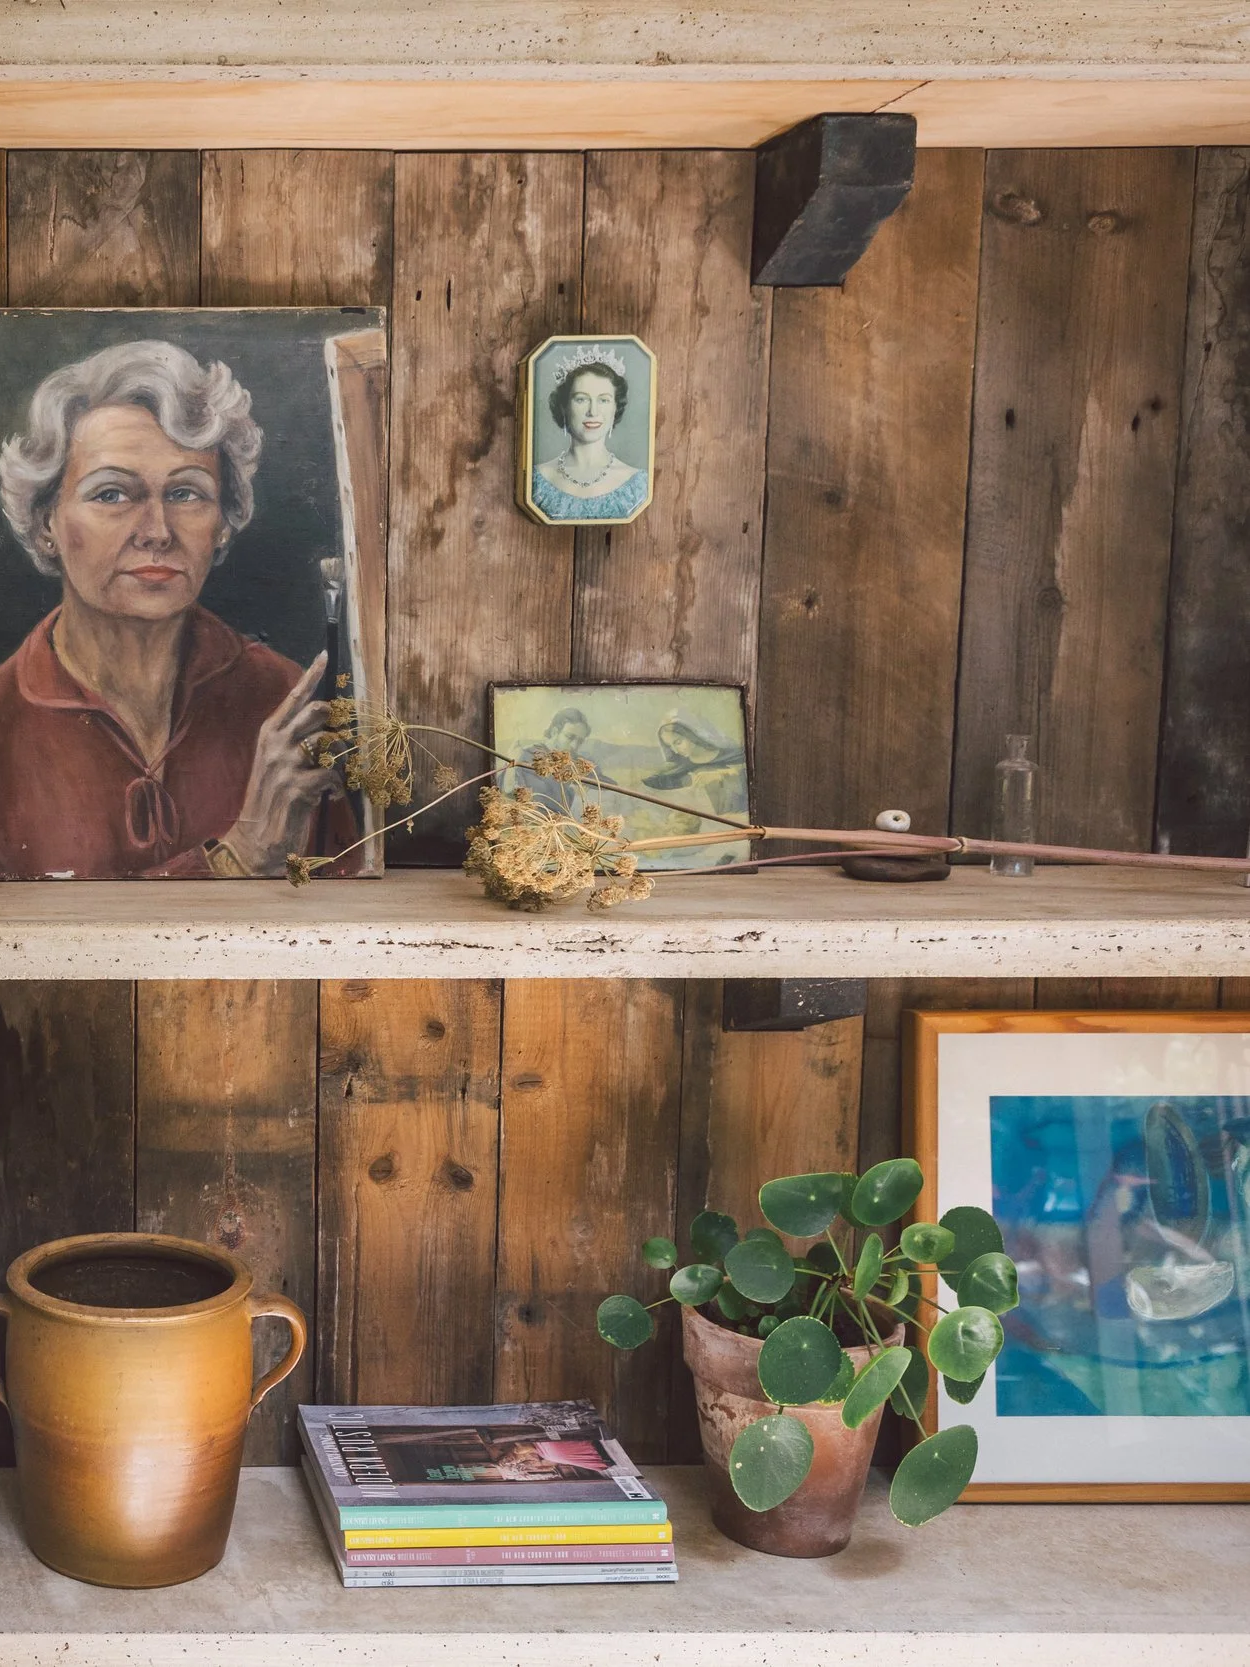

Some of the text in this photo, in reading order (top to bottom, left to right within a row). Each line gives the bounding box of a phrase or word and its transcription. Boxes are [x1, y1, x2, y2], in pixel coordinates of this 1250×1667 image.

[328, 1414, 400, 1498] MODERN RUSTIC
[350, 1553, 396, 1561] COUNTRY LIVING
